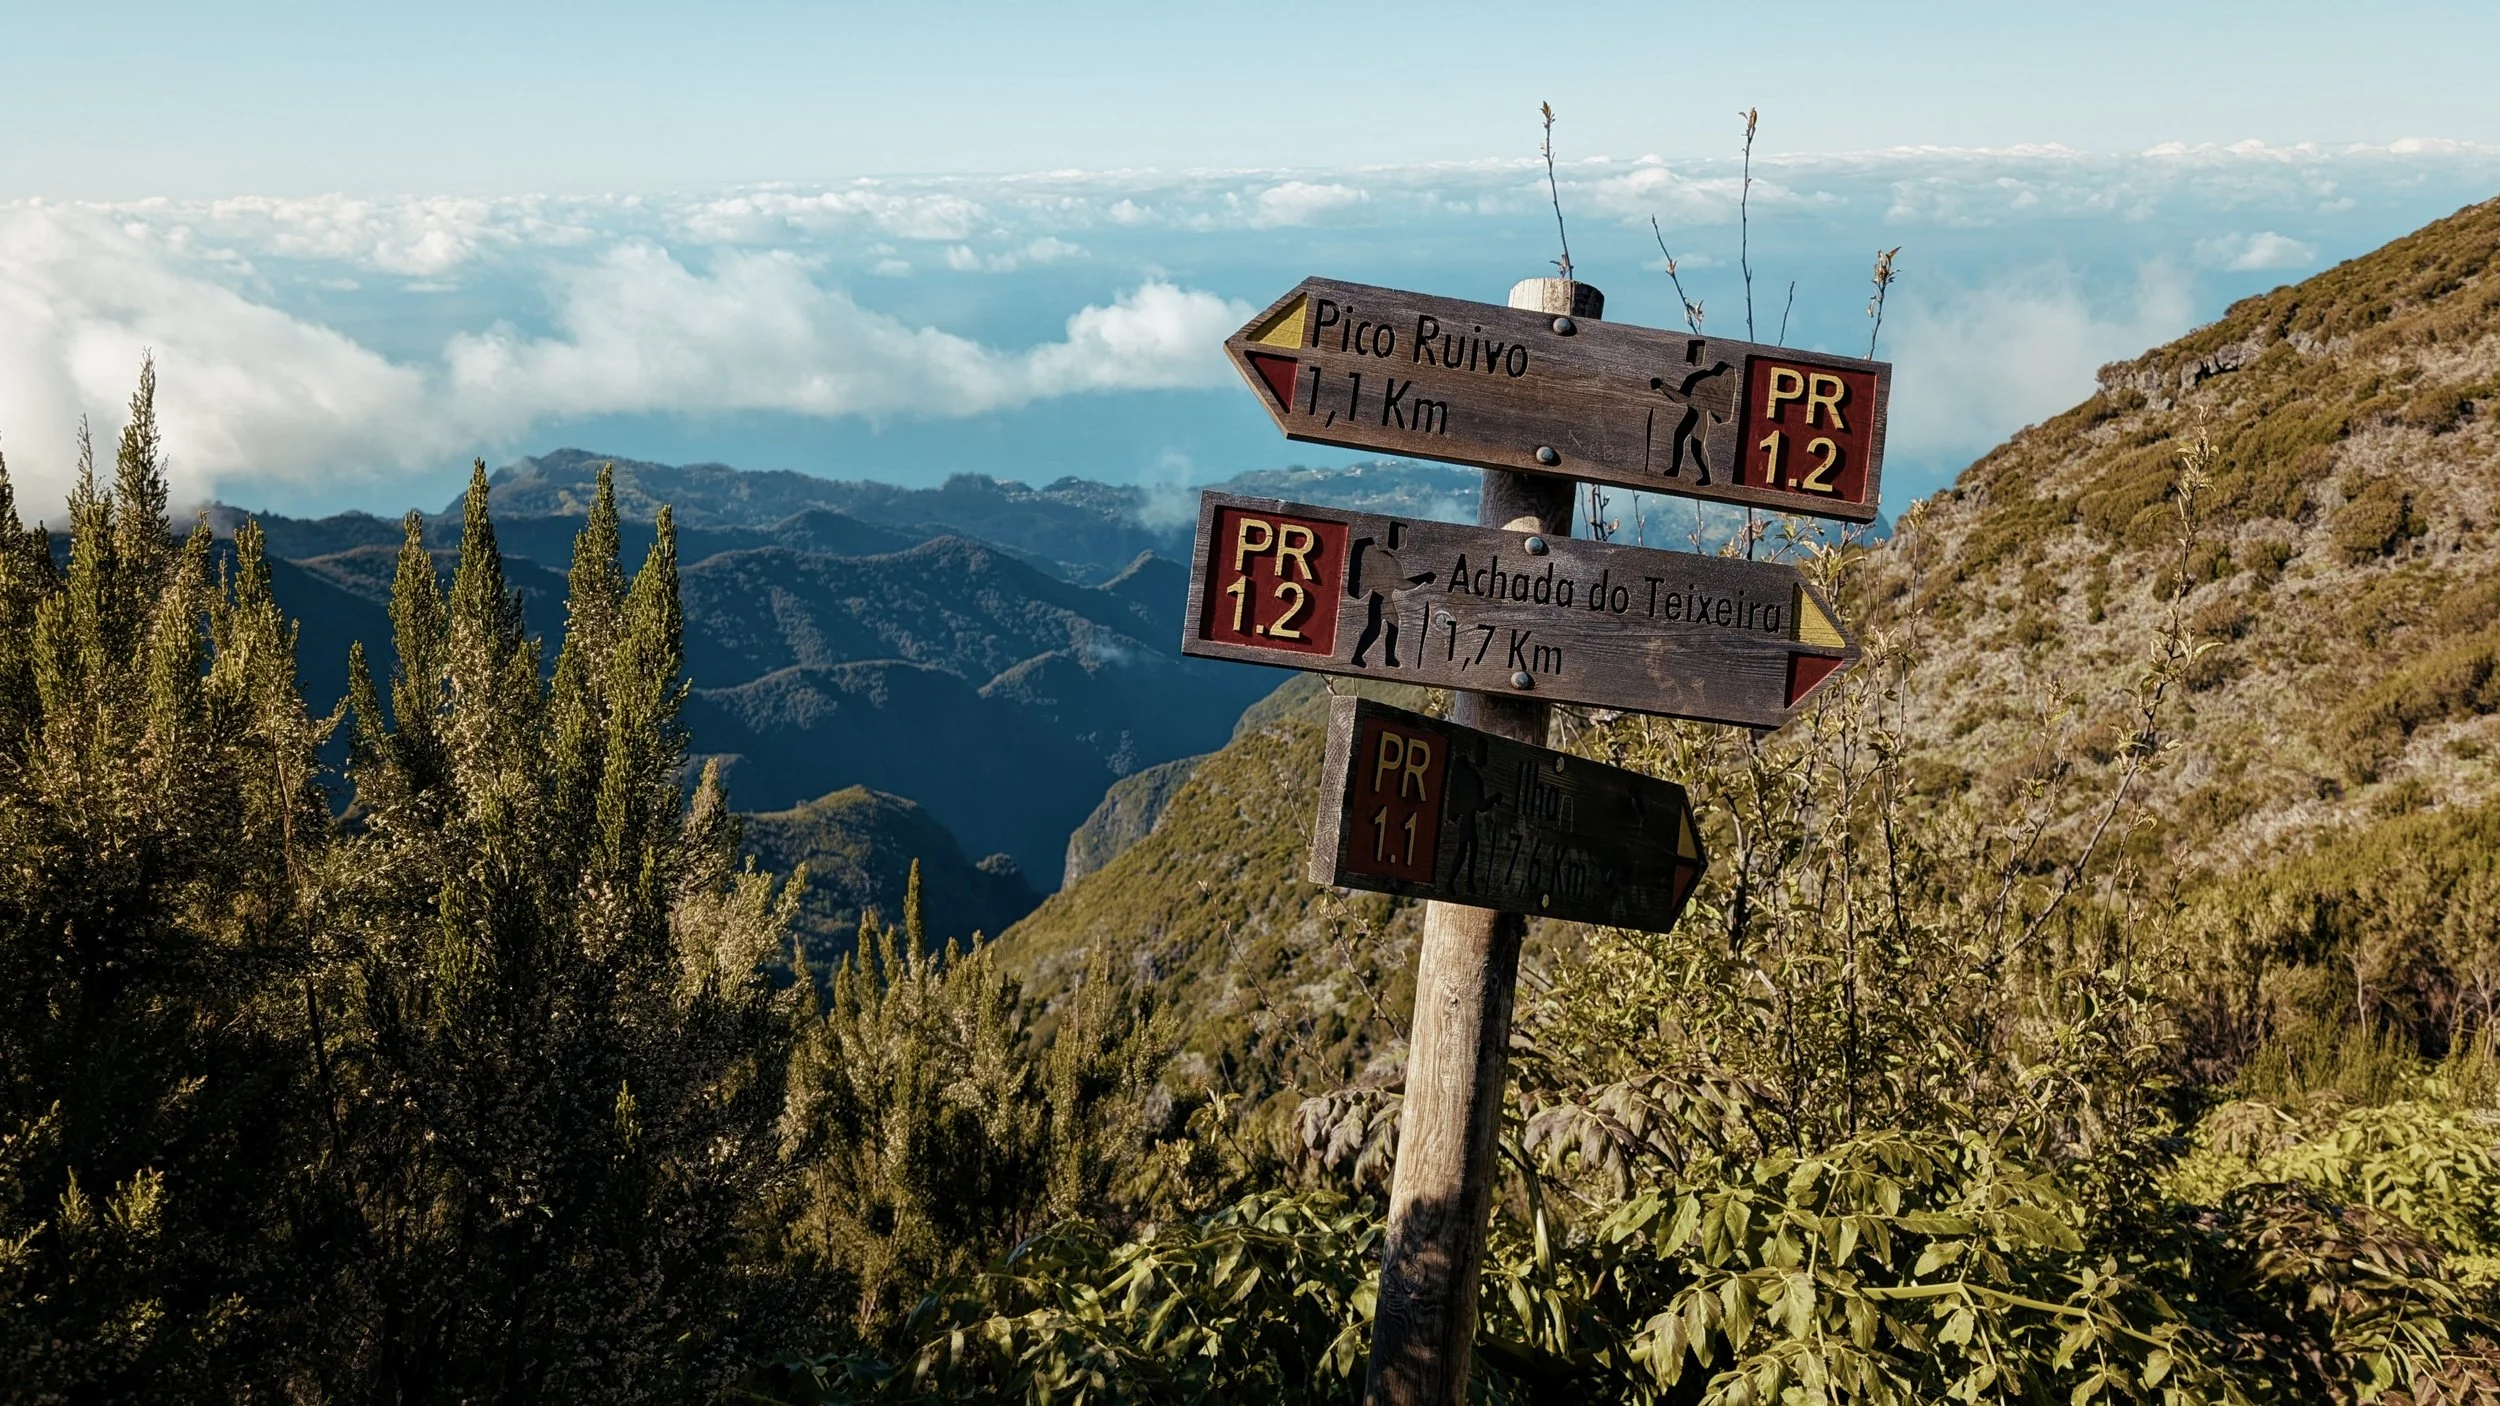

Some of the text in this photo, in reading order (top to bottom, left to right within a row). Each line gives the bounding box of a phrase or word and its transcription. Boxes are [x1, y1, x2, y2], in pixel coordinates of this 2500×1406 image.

[1311, 298, 1529, 380] Pico Ruivo
[1306, 366, 1449, 436] 1,1 Km
[1766, 367, 1845, 430] PR
[1759, 430, 1837, 493] 1.2
[1235, 517, 1315, 581] PR
[1226, 576, 1305, 640] 1.2
[1448, 553, 1783, 634] Achada do Teixeira
[1446, 621, 1563, 676] 1,7 Km
[1374, 731, 1432, 802] PR
[1372, 804, 1418, 867] 1.1
[1550, 842, 1587, 898] Km
